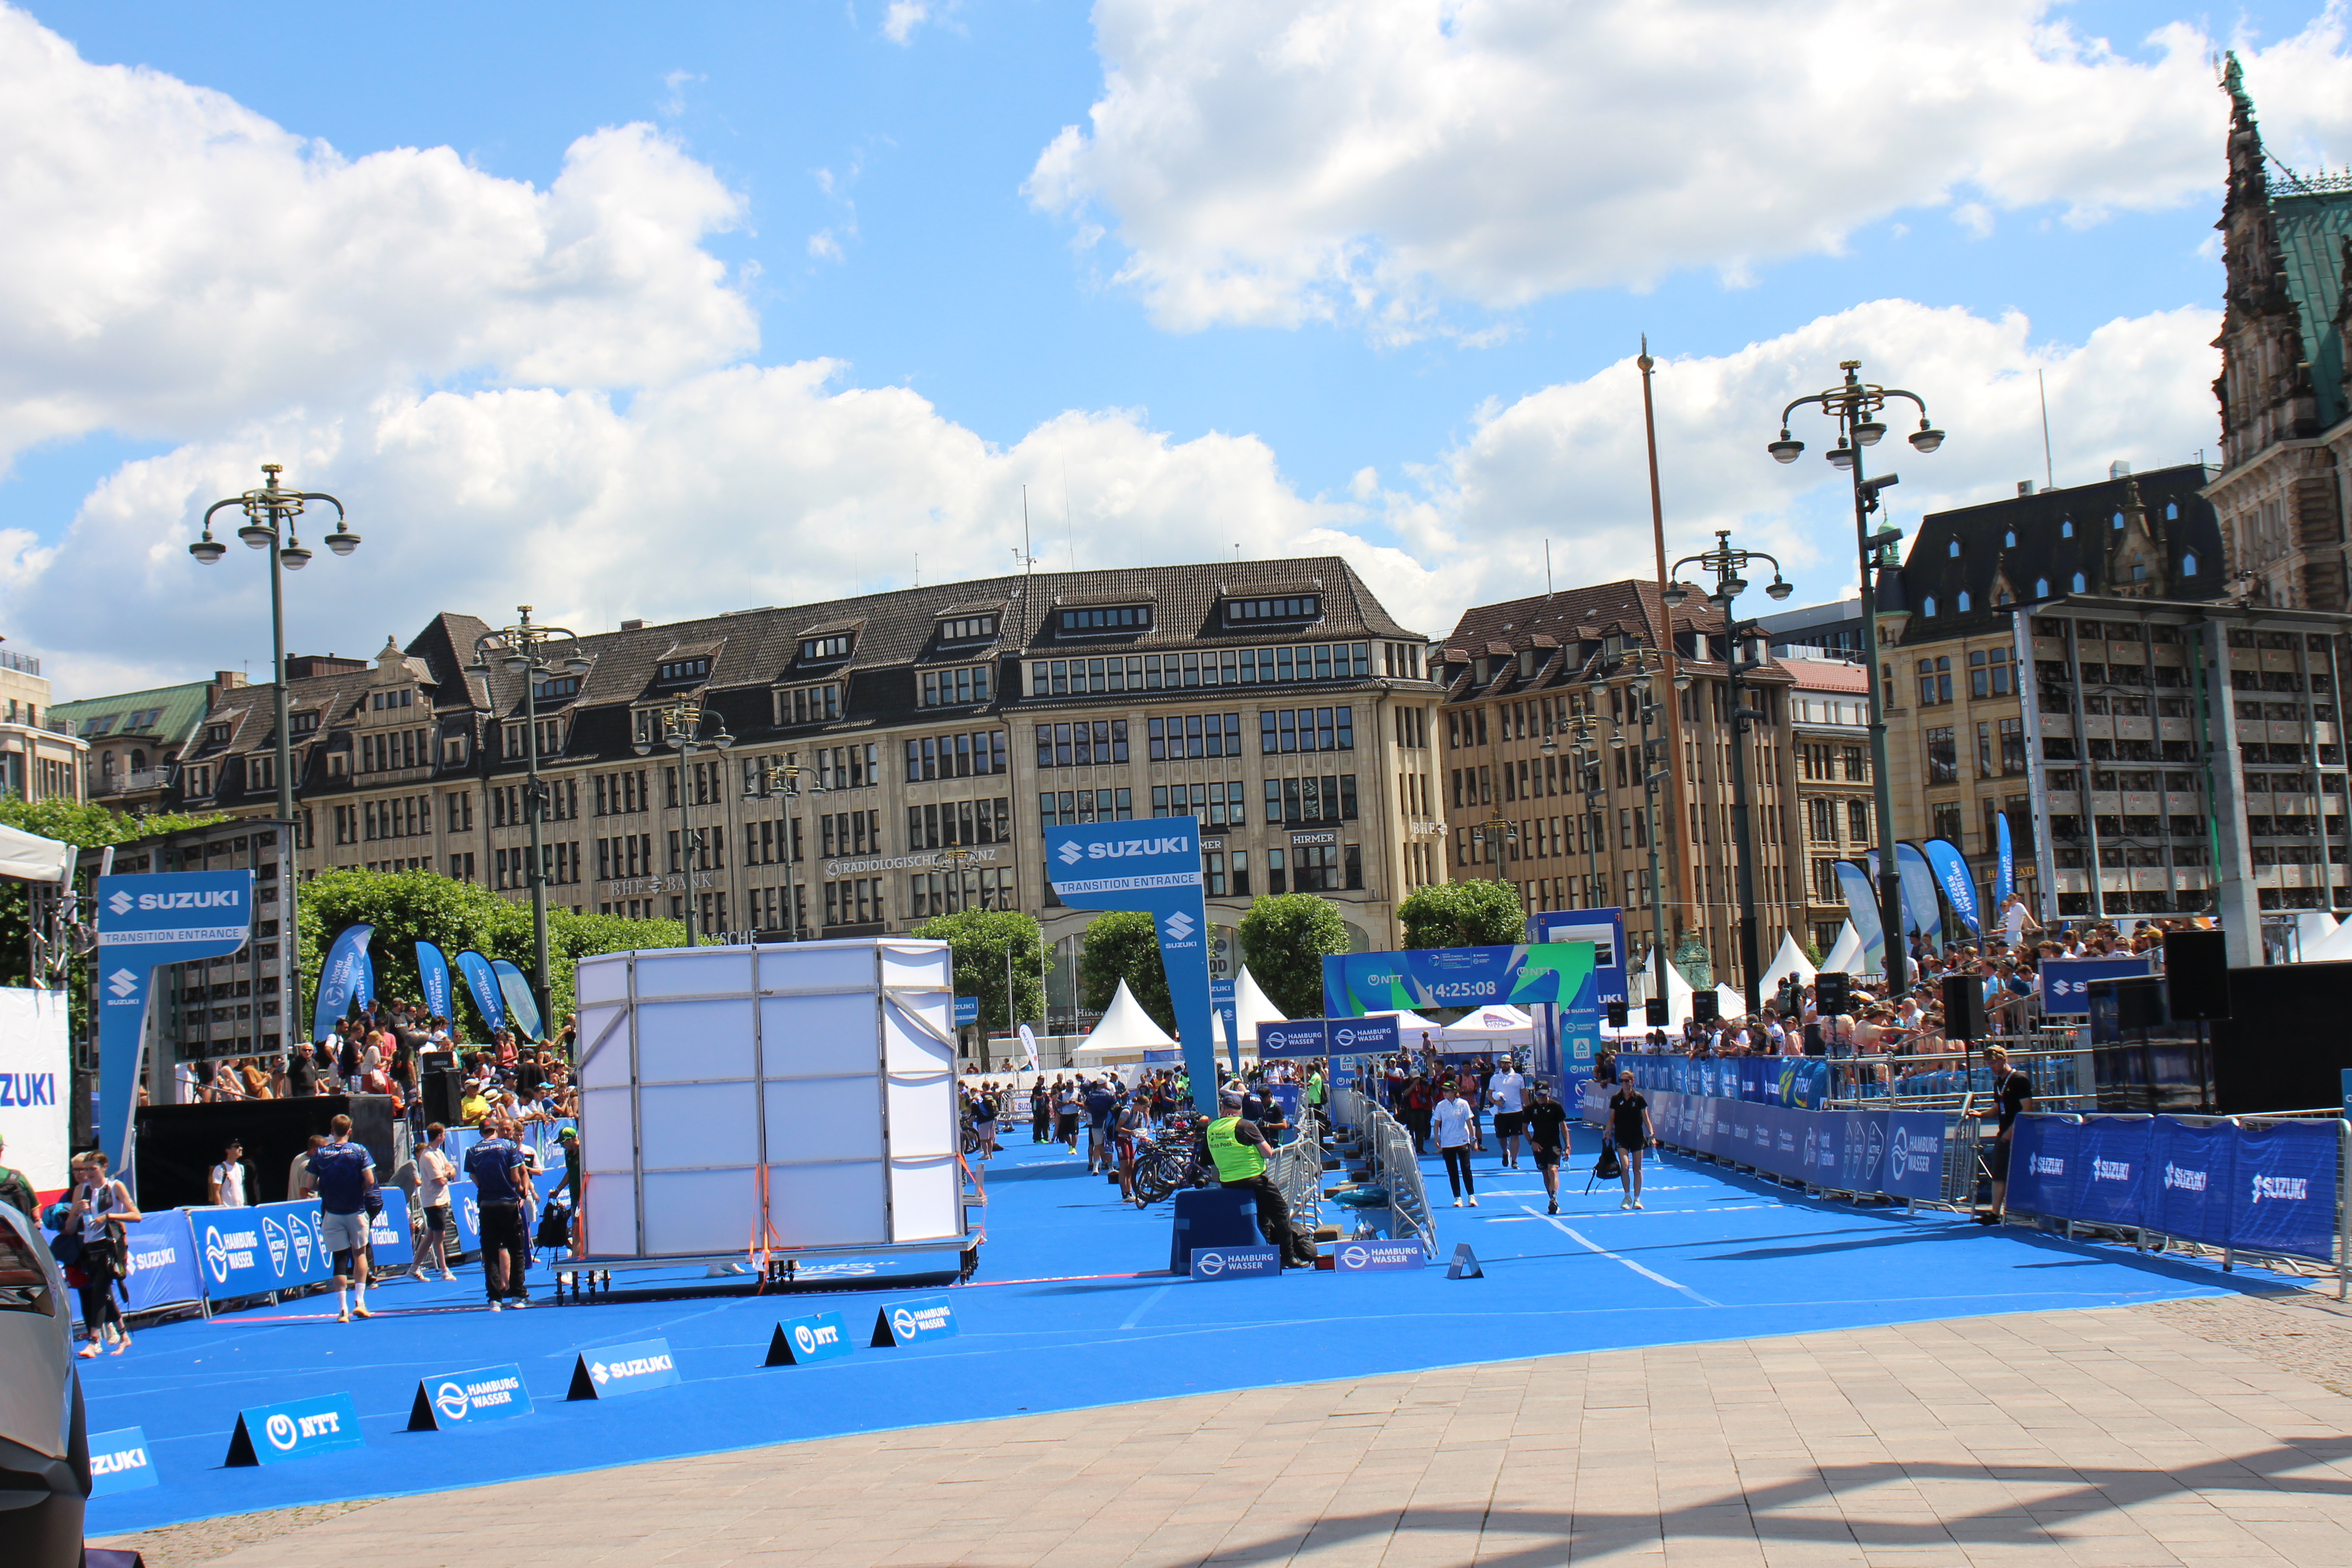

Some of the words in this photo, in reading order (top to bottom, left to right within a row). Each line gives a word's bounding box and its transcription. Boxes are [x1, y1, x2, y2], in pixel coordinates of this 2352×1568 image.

[1293, 834, 1334, 844] HIRMER
[1088, 837, 1188, 859] SUZUKI
[843, 854, 937, 874] RADIOLOGISCHE
[612, 880, 643, 896] BHF
[666, 873, 712, 891] BANK
[1060, 879, 1130, 893] TRANSITION
[1133, 874, 1195, 888] ENTRANCE
[139, 890, 239, 910] SUZUKI
[105, 931, 174, 944] TRANSITION
[179, 928, 239, 940] ENTRANCE
[330, 960, 343, 984] World
[338, 952, 355, 985] Triathlon
[1530, 967, 1552, 975] NTT
[1381, 975, 1402, 984] NTT
[1426, 981, 1496, 998] 14:25:08
[0, 1073, 55, 1107] ZUKI
[1909, 1136, 1937, 1153] HAMBURG
[1908, 1155, 1930, 1172] WASSER
[2037, 1156, 2064, 1176] SUZUKI
[2101, 1160, 2130, 1181] SUZUKI
[2174, 1167, 2207, 1191] SUZUKI
[2262, 1176, 2308, 1200] SUZUKI
[224, 1231, 258, 1250] HAMBURG
[271, 1239, 286, 1250] ACTIVE
[296, 1235, 309, 1247] ACTIVE
[370, 1230, 399, 1245] Triathlon
[136, 1247, 176, 1270] SUZUKI
[228, 1251, 254, 1269] WASSER
[274, 1251, 283, 1261] CITY
[298, 1247, 307, 1258] CITY
[1228, 1253, 1274, 1263] HAMBURG
[1371, 1247, 1418, 1256] HAMBURG
[1372, 1254, 1407, 1264] WASSER
[1228, 1261, 1263, 1270] WASSER
[914, 1306, 950, 1321] HAMBURG
[917, 1317, 946, 1330] WASSER
[813, 1326, 839, 1345] NTT
[611, 1354, 672, 1379] SUZUKI
[466, 1377, 519, 1396] HAMBURG
[470, 1391, 512, 1408] WASSER
[298, 1411, 339, 1437] NTT
